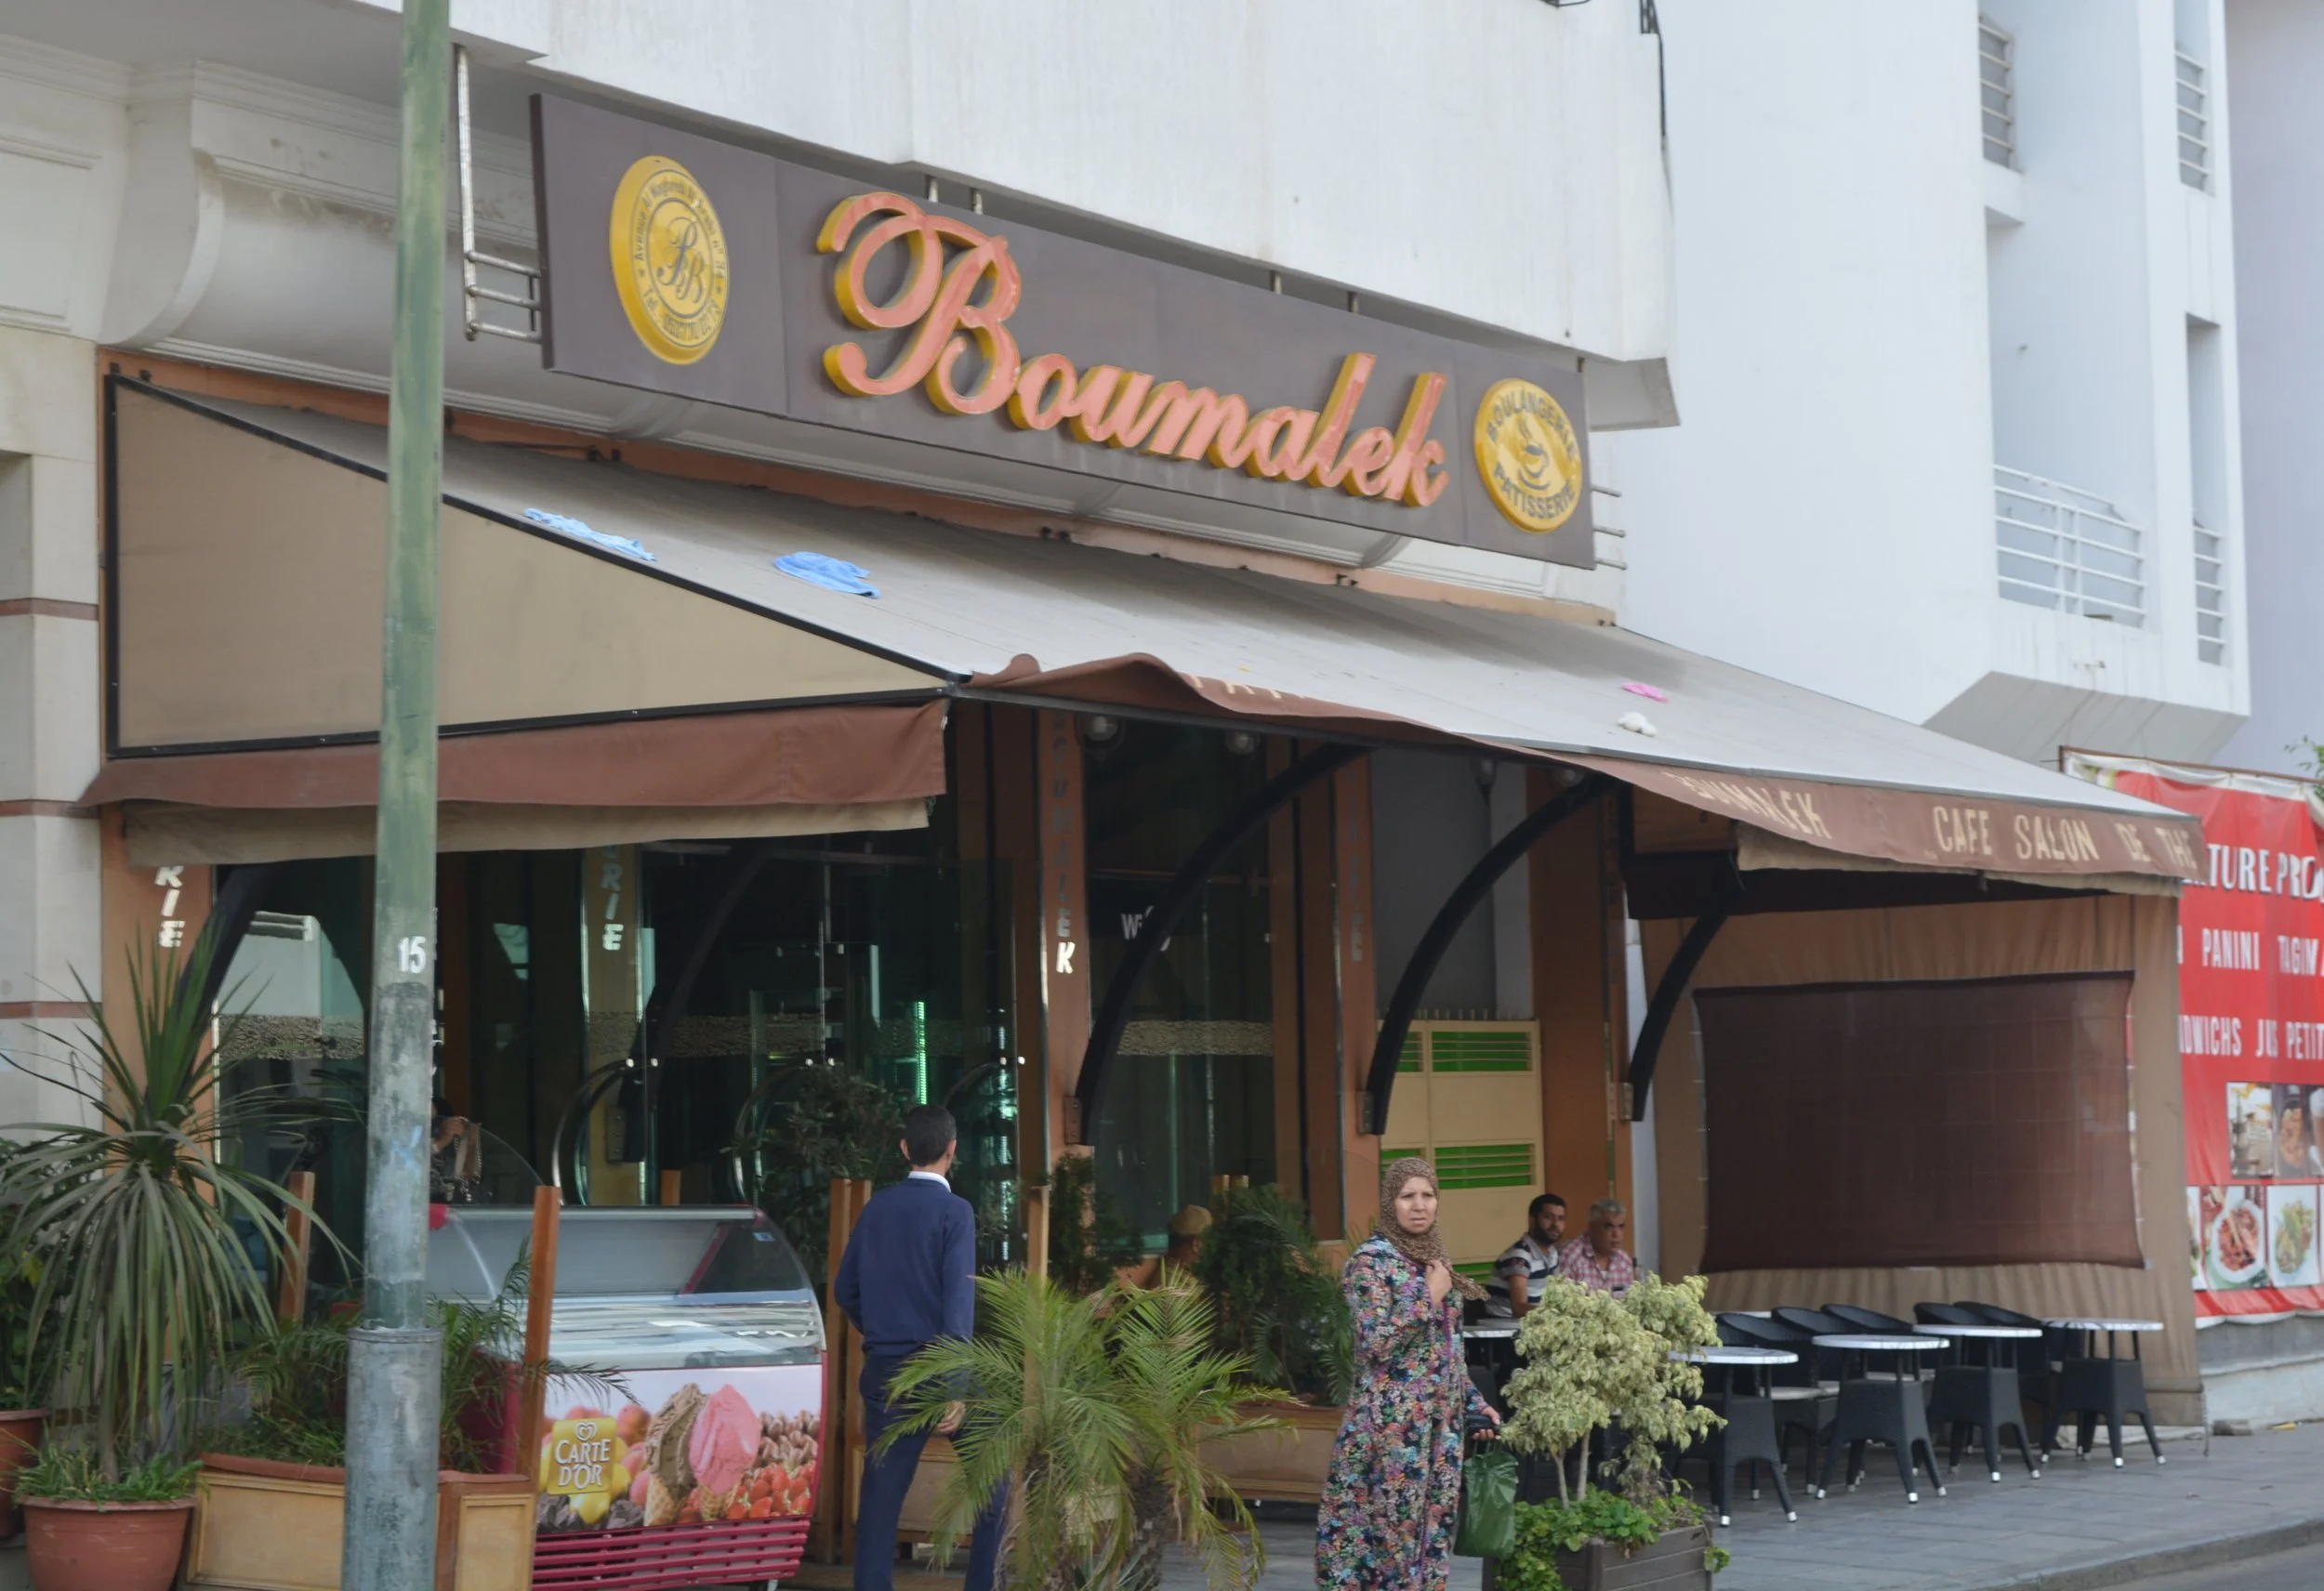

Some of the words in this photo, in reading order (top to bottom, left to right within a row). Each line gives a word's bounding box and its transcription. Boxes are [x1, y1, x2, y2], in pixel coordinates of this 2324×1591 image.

[817, 191, 1450, 507] Boumalek
[1934, 806, 1993, 856] CAFE
[2014, 814, 2100, 861] SALON
[2114, 823, 2151, 862] DE
[2182, 843, 2272, 892] TURE
[398, 935, 427, 974] 15
[2202, 927, 2260, 971] PANINI
[555, 1439, 611, 1467] CARTE
[558, 1464, 602, 1490] D'OR
